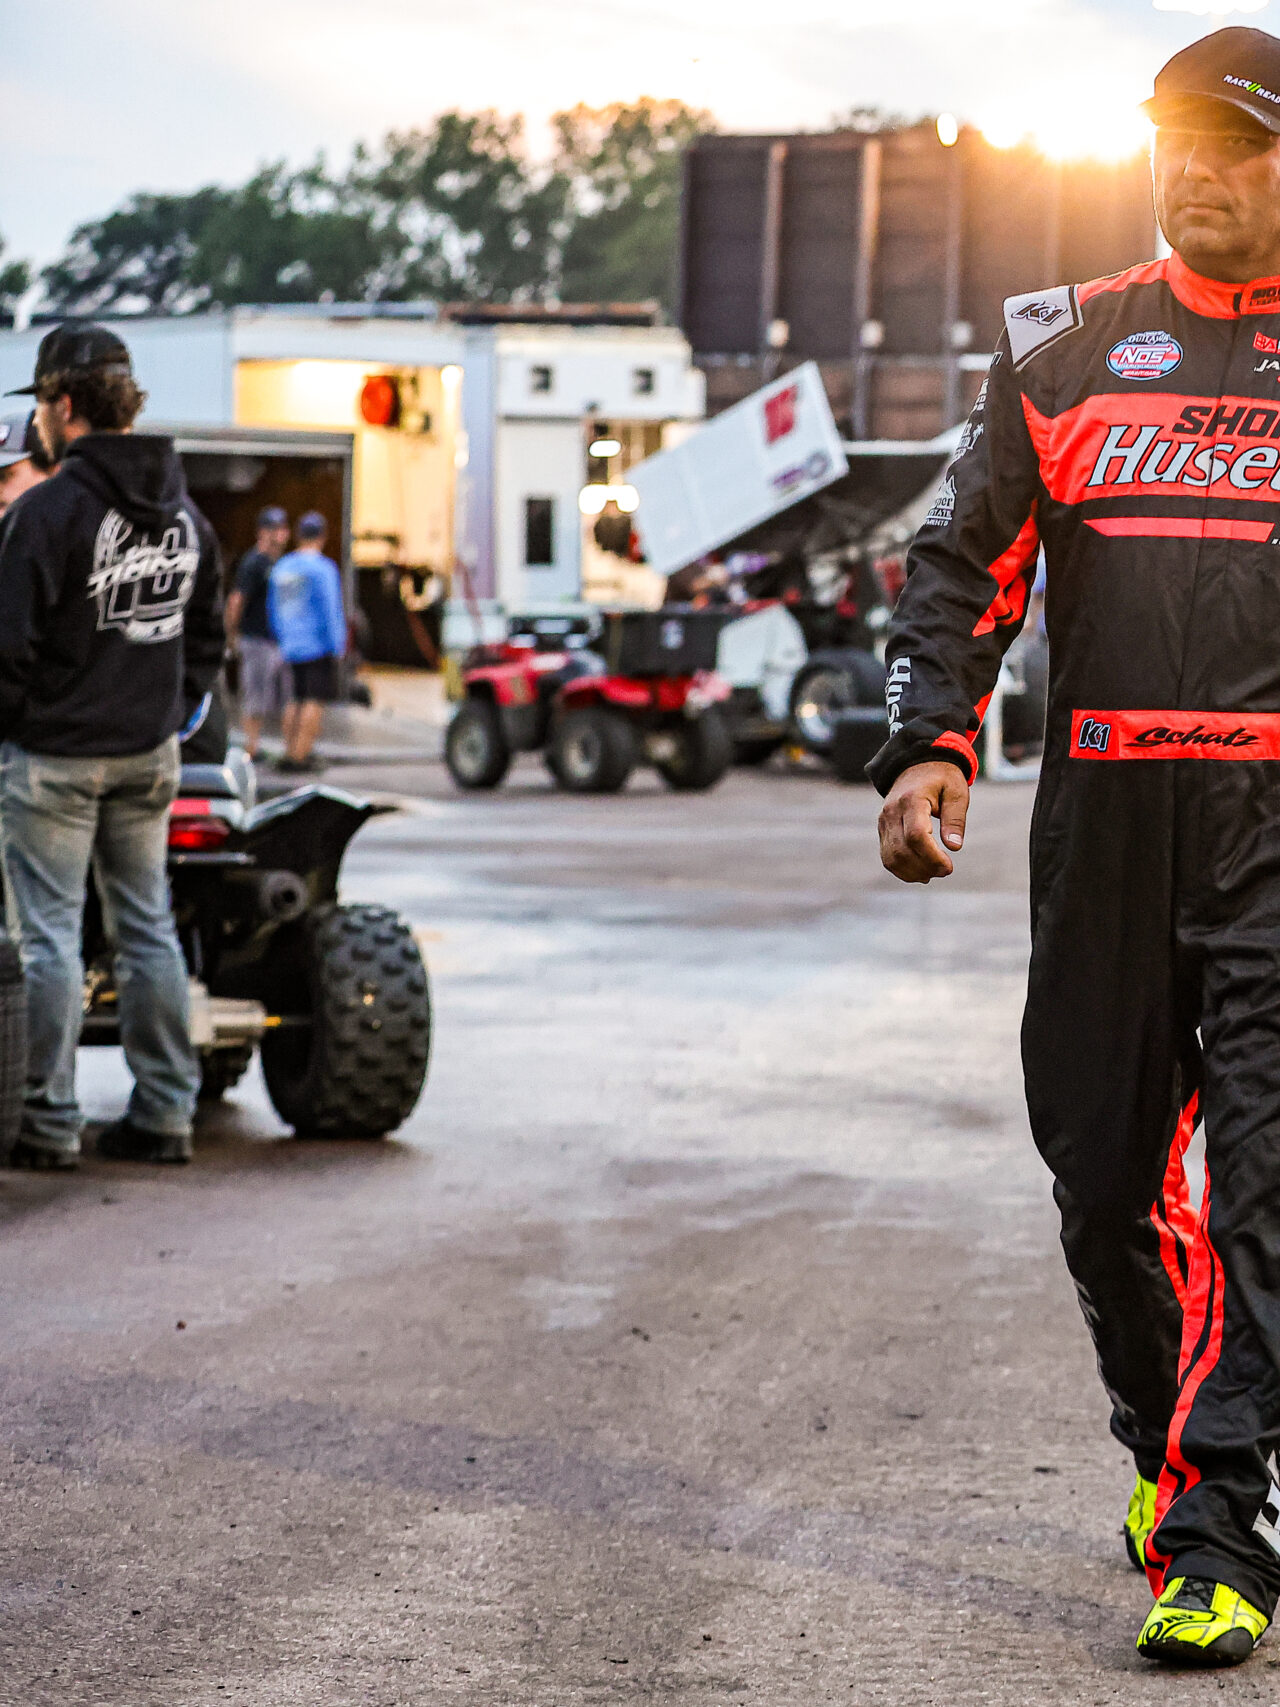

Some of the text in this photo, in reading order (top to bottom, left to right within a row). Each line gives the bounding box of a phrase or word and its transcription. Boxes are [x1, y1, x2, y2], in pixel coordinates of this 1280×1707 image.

[1118, 344, 1174, 365] NOS
[1078, 718, 1111, 752] K1
[1125, 725, 1260, 748] Schatz
